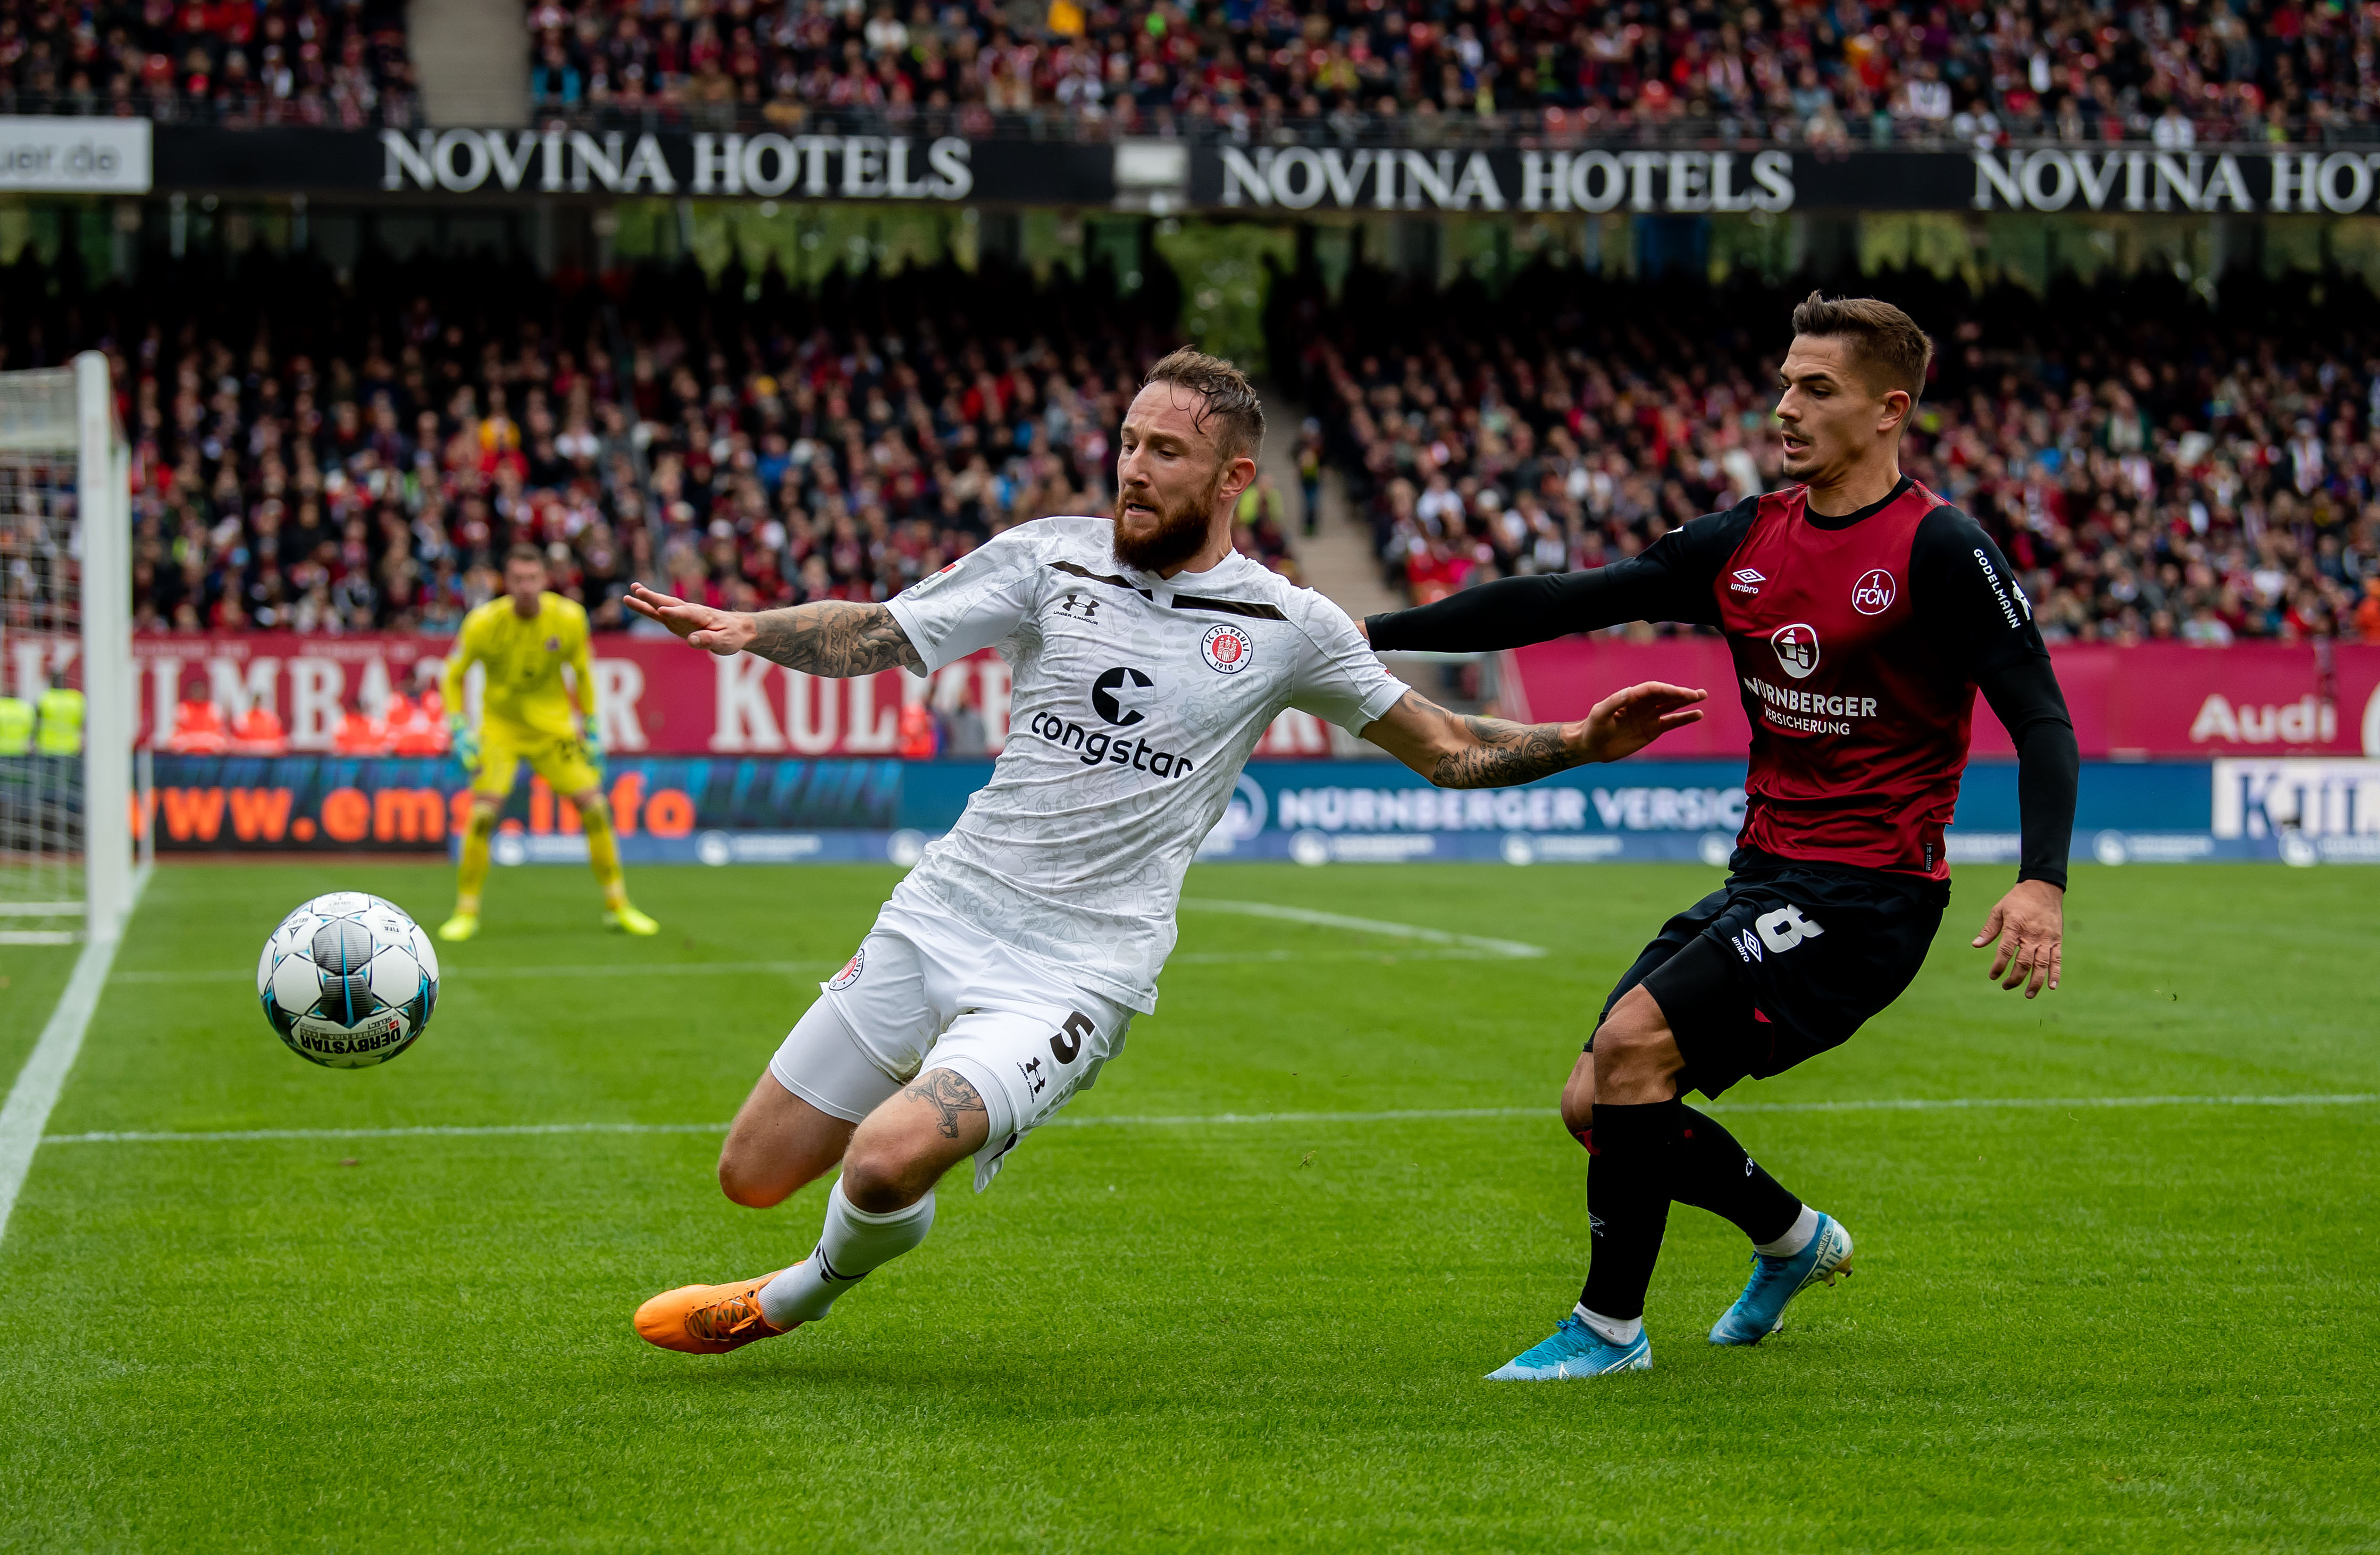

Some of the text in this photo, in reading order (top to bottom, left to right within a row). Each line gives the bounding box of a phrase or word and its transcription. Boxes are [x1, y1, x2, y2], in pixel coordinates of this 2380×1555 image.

[381, 129, 974, 200] NOVINA HOTELS
[1221, 147, 1795, 212] NOVINA HOTELS
[1973, 148, 2380, 213] NOVINA HO
[1730, 582, 1758, 594] umbro
[1856, 589, 1889, 606] FCN
[1974, 549, 2021, 629] GODELMANN
[1072, 615, 1098, 625] ARMOUR
[1205, 634, 1214, 644] FC
[1230, 629, 1250, 651] PAULI
[1214, 661, 1233, 671] 1910
[1744, 677, 1876, 717] NÜRNBERGER
[1764, 704, 1850, 735] VERSICHERUNG
[2189, 692, 2337, 744] Audi
[1031, 712, 1193, 779] congstar
[1755, 904, 1825, 953] 8
[1731, 937, 1749, 962] umbro
[367, 1016, 392, 1030] SELECT
[1049, 1011, 1095, 1065] 5
[300, 1027, 400, 1055] DERBYSTAR
[1016, 1061, 1028, 1081] UNDER
[1816, 1227, 1832, 1257] MERC
